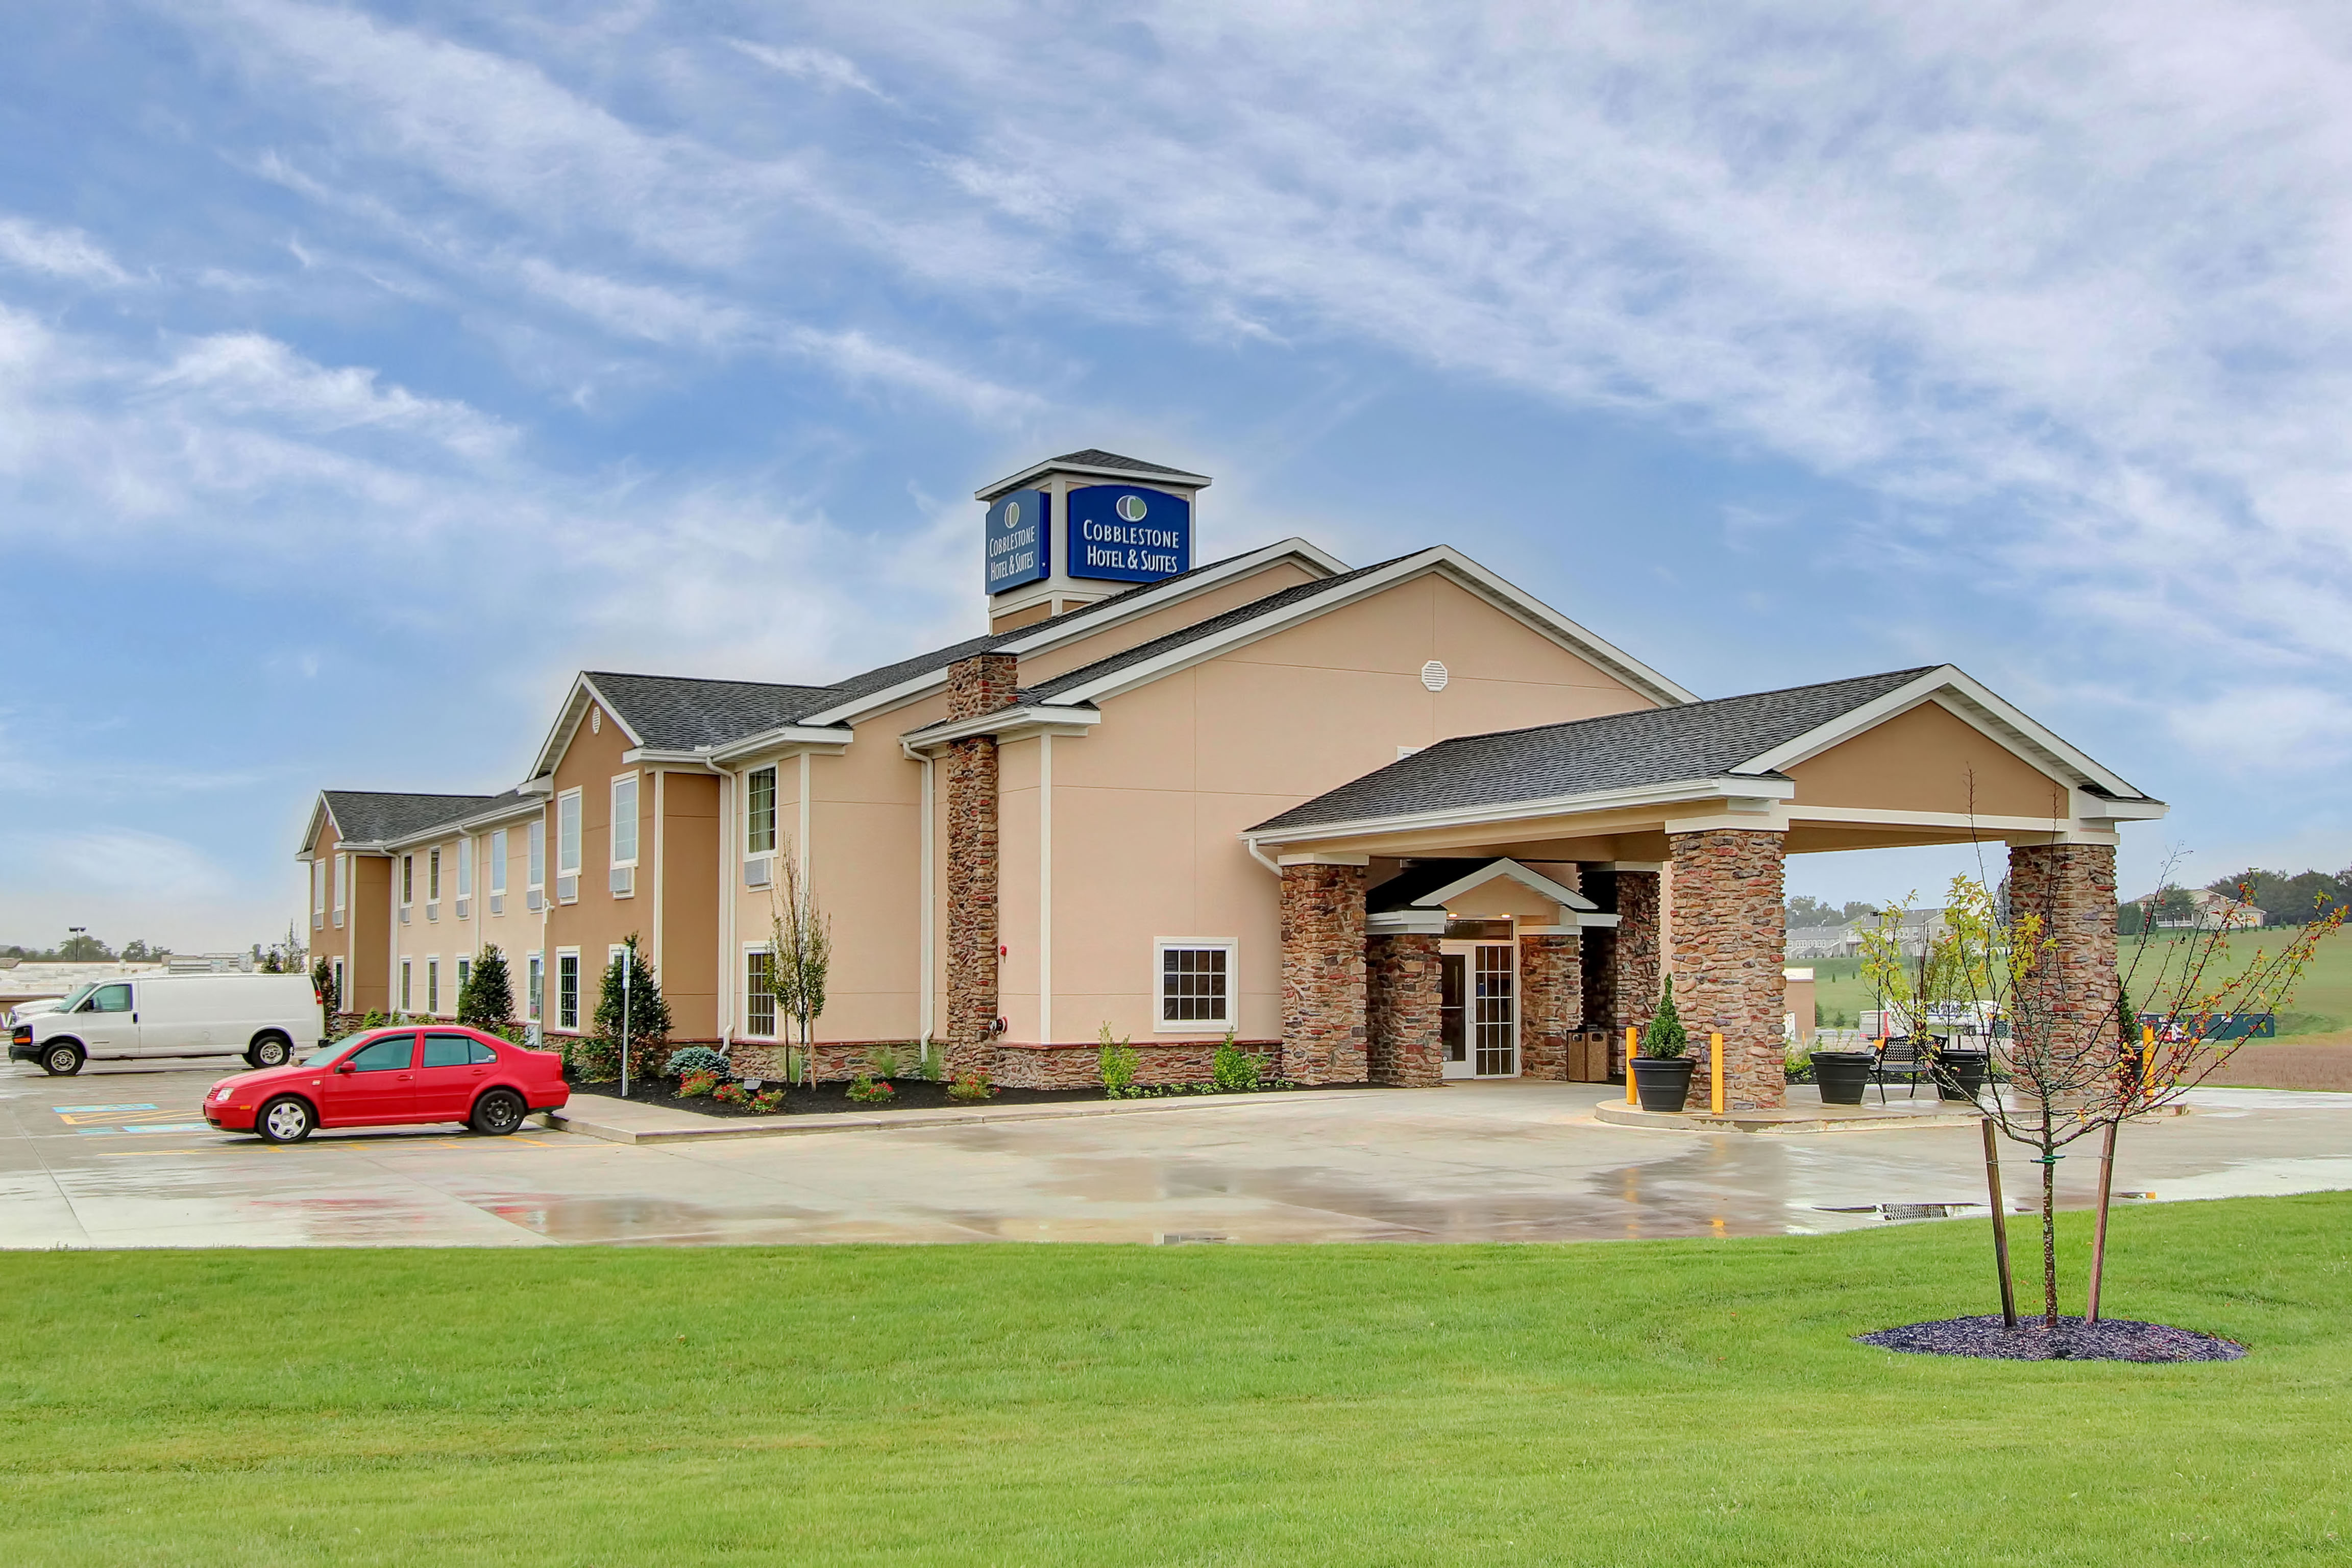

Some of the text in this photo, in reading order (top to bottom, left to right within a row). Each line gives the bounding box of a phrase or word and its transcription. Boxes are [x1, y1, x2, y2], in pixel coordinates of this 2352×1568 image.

[989, 525, 1035, 558] COBBLESTONE
[1083, 519, 1179, 549] COBBLESTONE
[990, 551, 1034, 582] HOTEL & SUITES
[1087, 545, 1177, 573] HOTEL & SUITES
